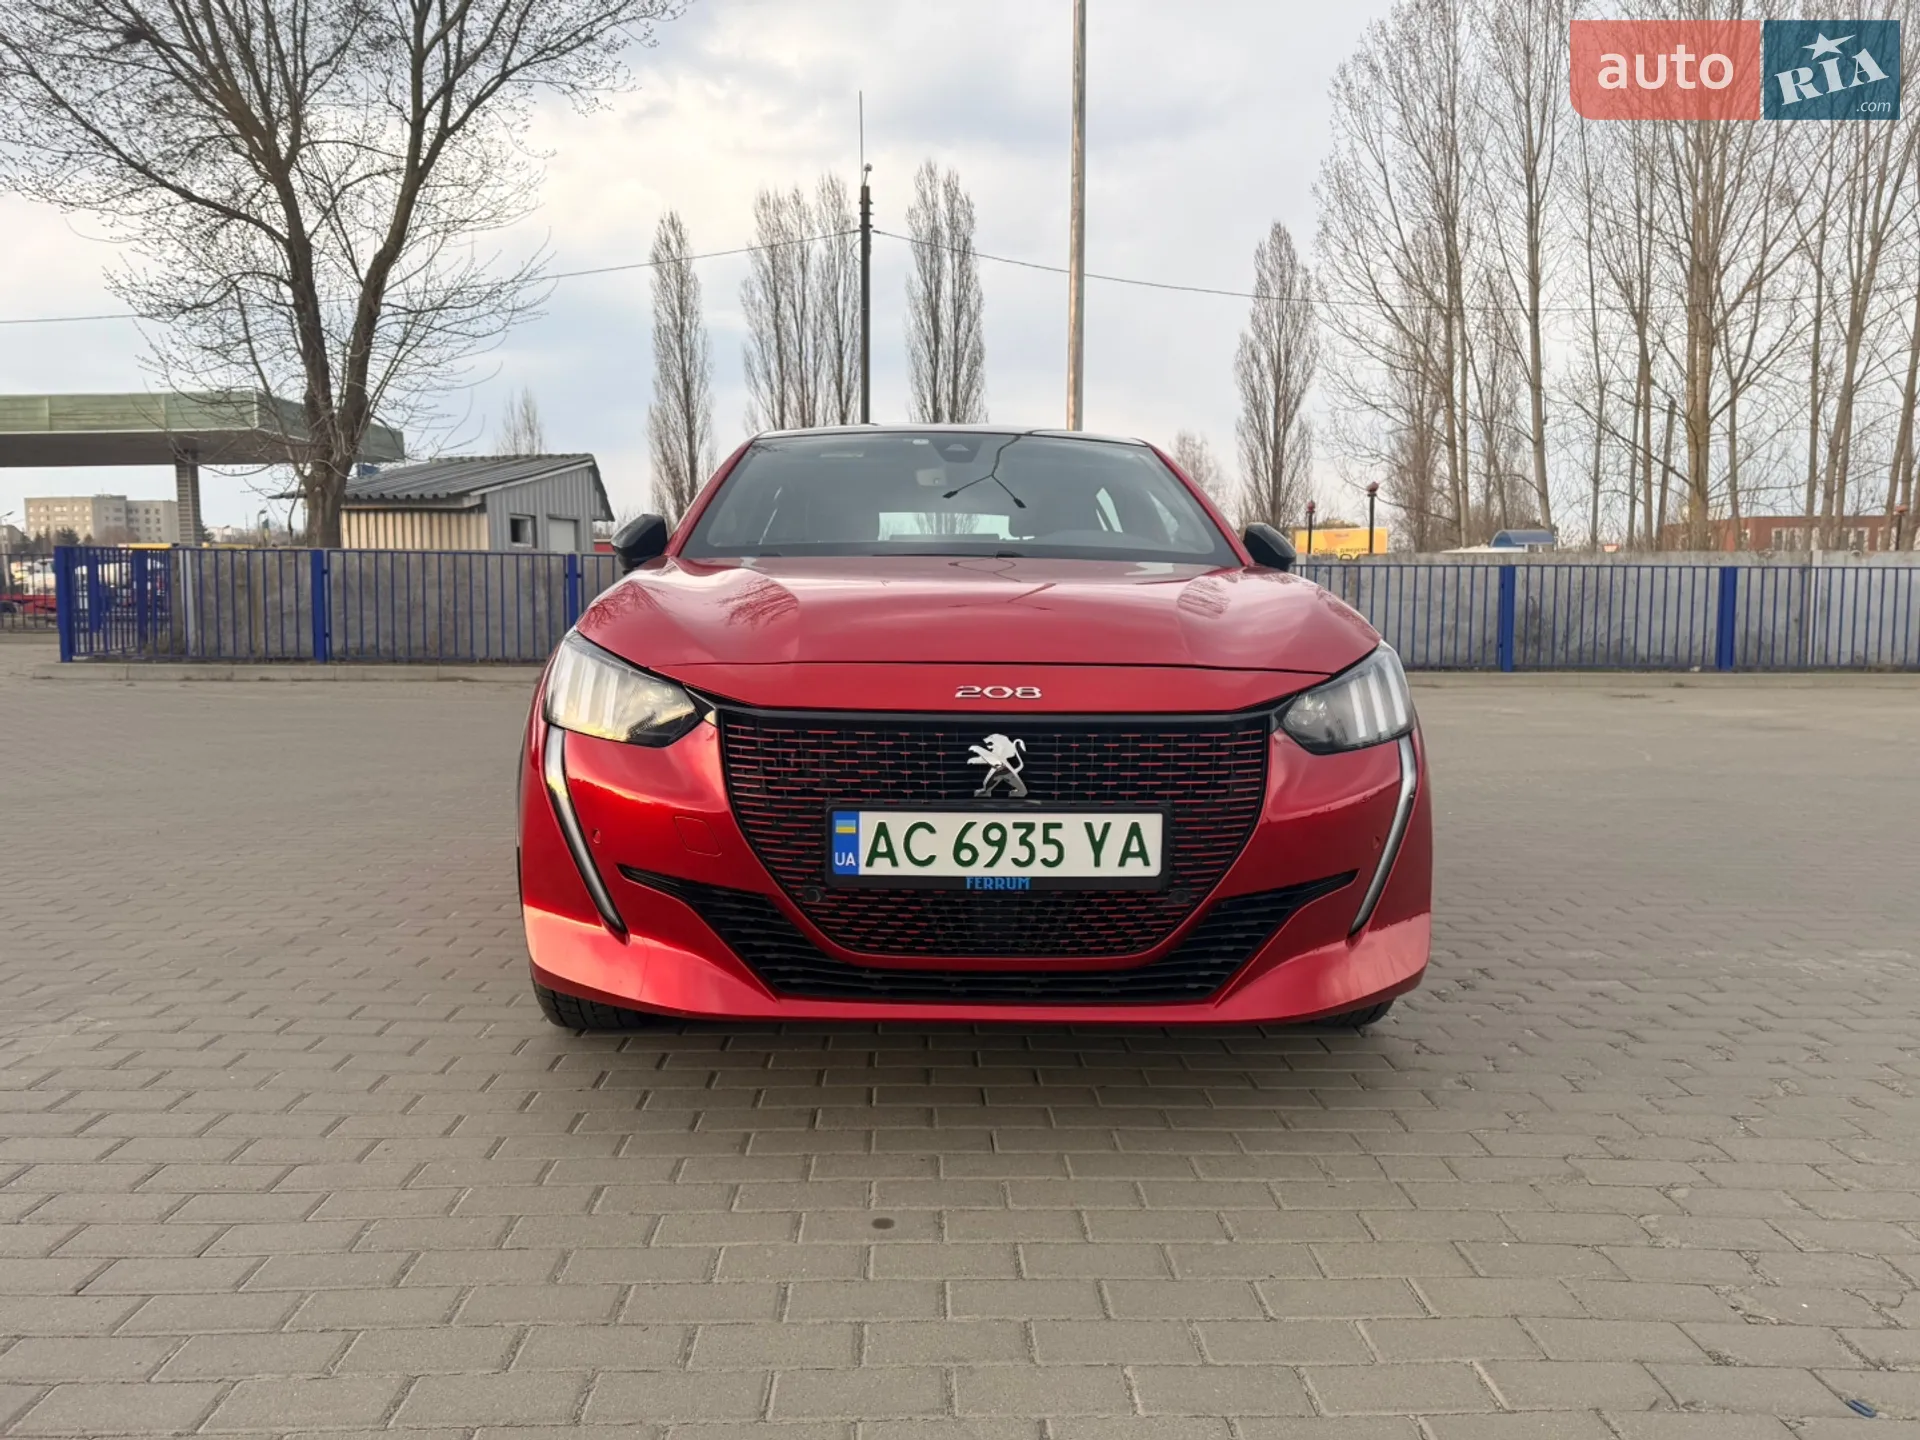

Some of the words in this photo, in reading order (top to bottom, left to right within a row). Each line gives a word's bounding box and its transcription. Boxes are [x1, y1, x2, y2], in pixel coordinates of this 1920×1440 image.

[954, 685, 1043, 699] 208
[865, 821, 937, 868] AC
[952, 821, 1065, 868] 6935
[1084, 821, 1151, 868] YA
[834, 852, 856, 867] UA
[965, 877, 1032, 891] FERRUM
